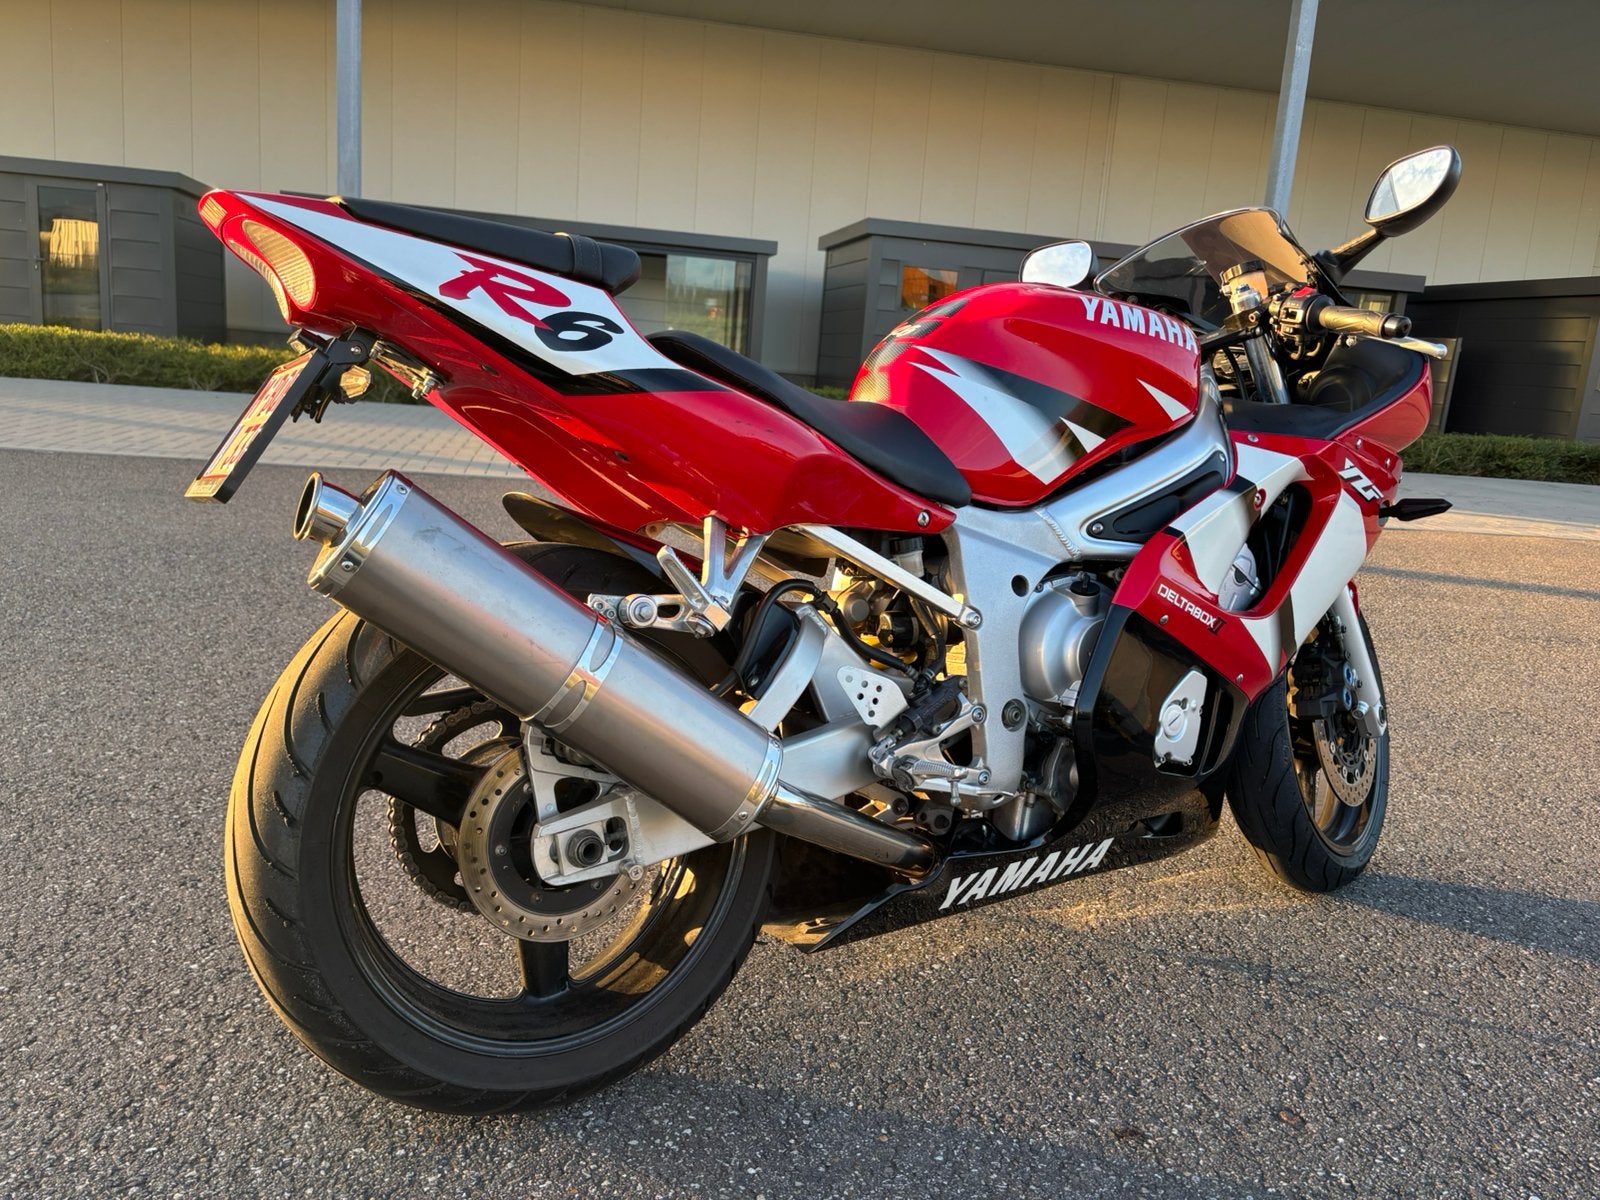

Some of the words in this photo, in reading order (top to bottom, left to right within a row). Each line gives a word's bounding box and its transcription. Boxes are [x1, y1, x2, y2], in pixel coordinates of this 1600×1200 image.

[438, 251, 625, 352] R6
[1080, 295, 1199, 355] YAMAHA
[1338, 457, 1384, 501] YZF
[938, 837, 1115, 910] YAMAHA
